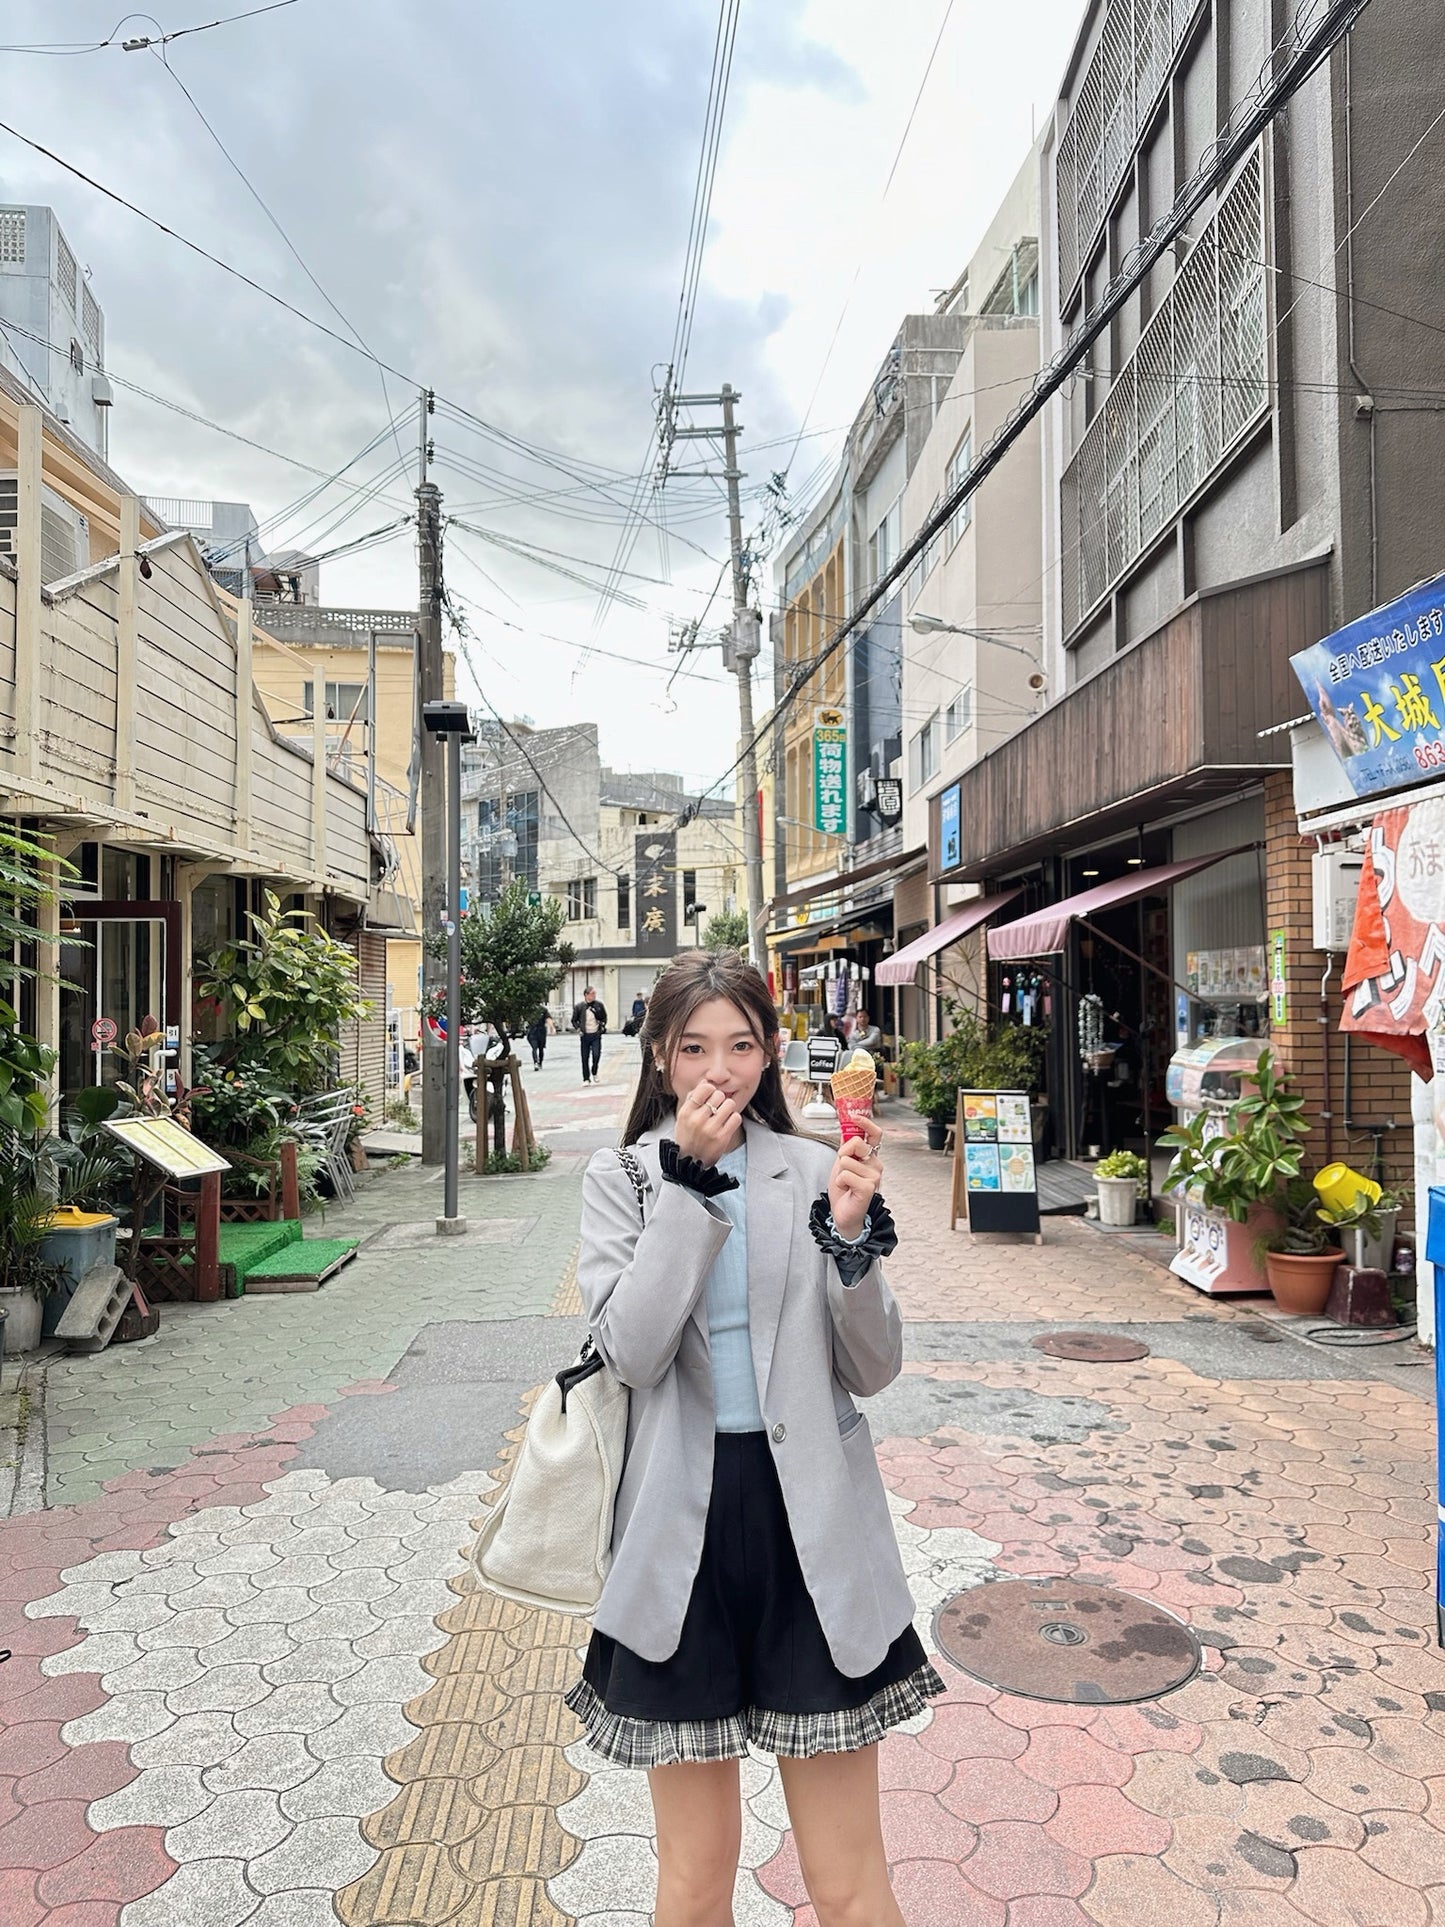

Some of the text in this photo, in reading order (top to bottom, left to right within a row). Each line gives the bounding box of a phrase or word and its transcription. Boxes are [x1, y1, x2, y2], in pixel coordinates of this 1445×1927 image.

[1329, 608, 1443, 685] 全国へ配送いたします
[818, 743, 843, 832] 荷物送れます
[810, 1059, 834, 1068] Coffee
